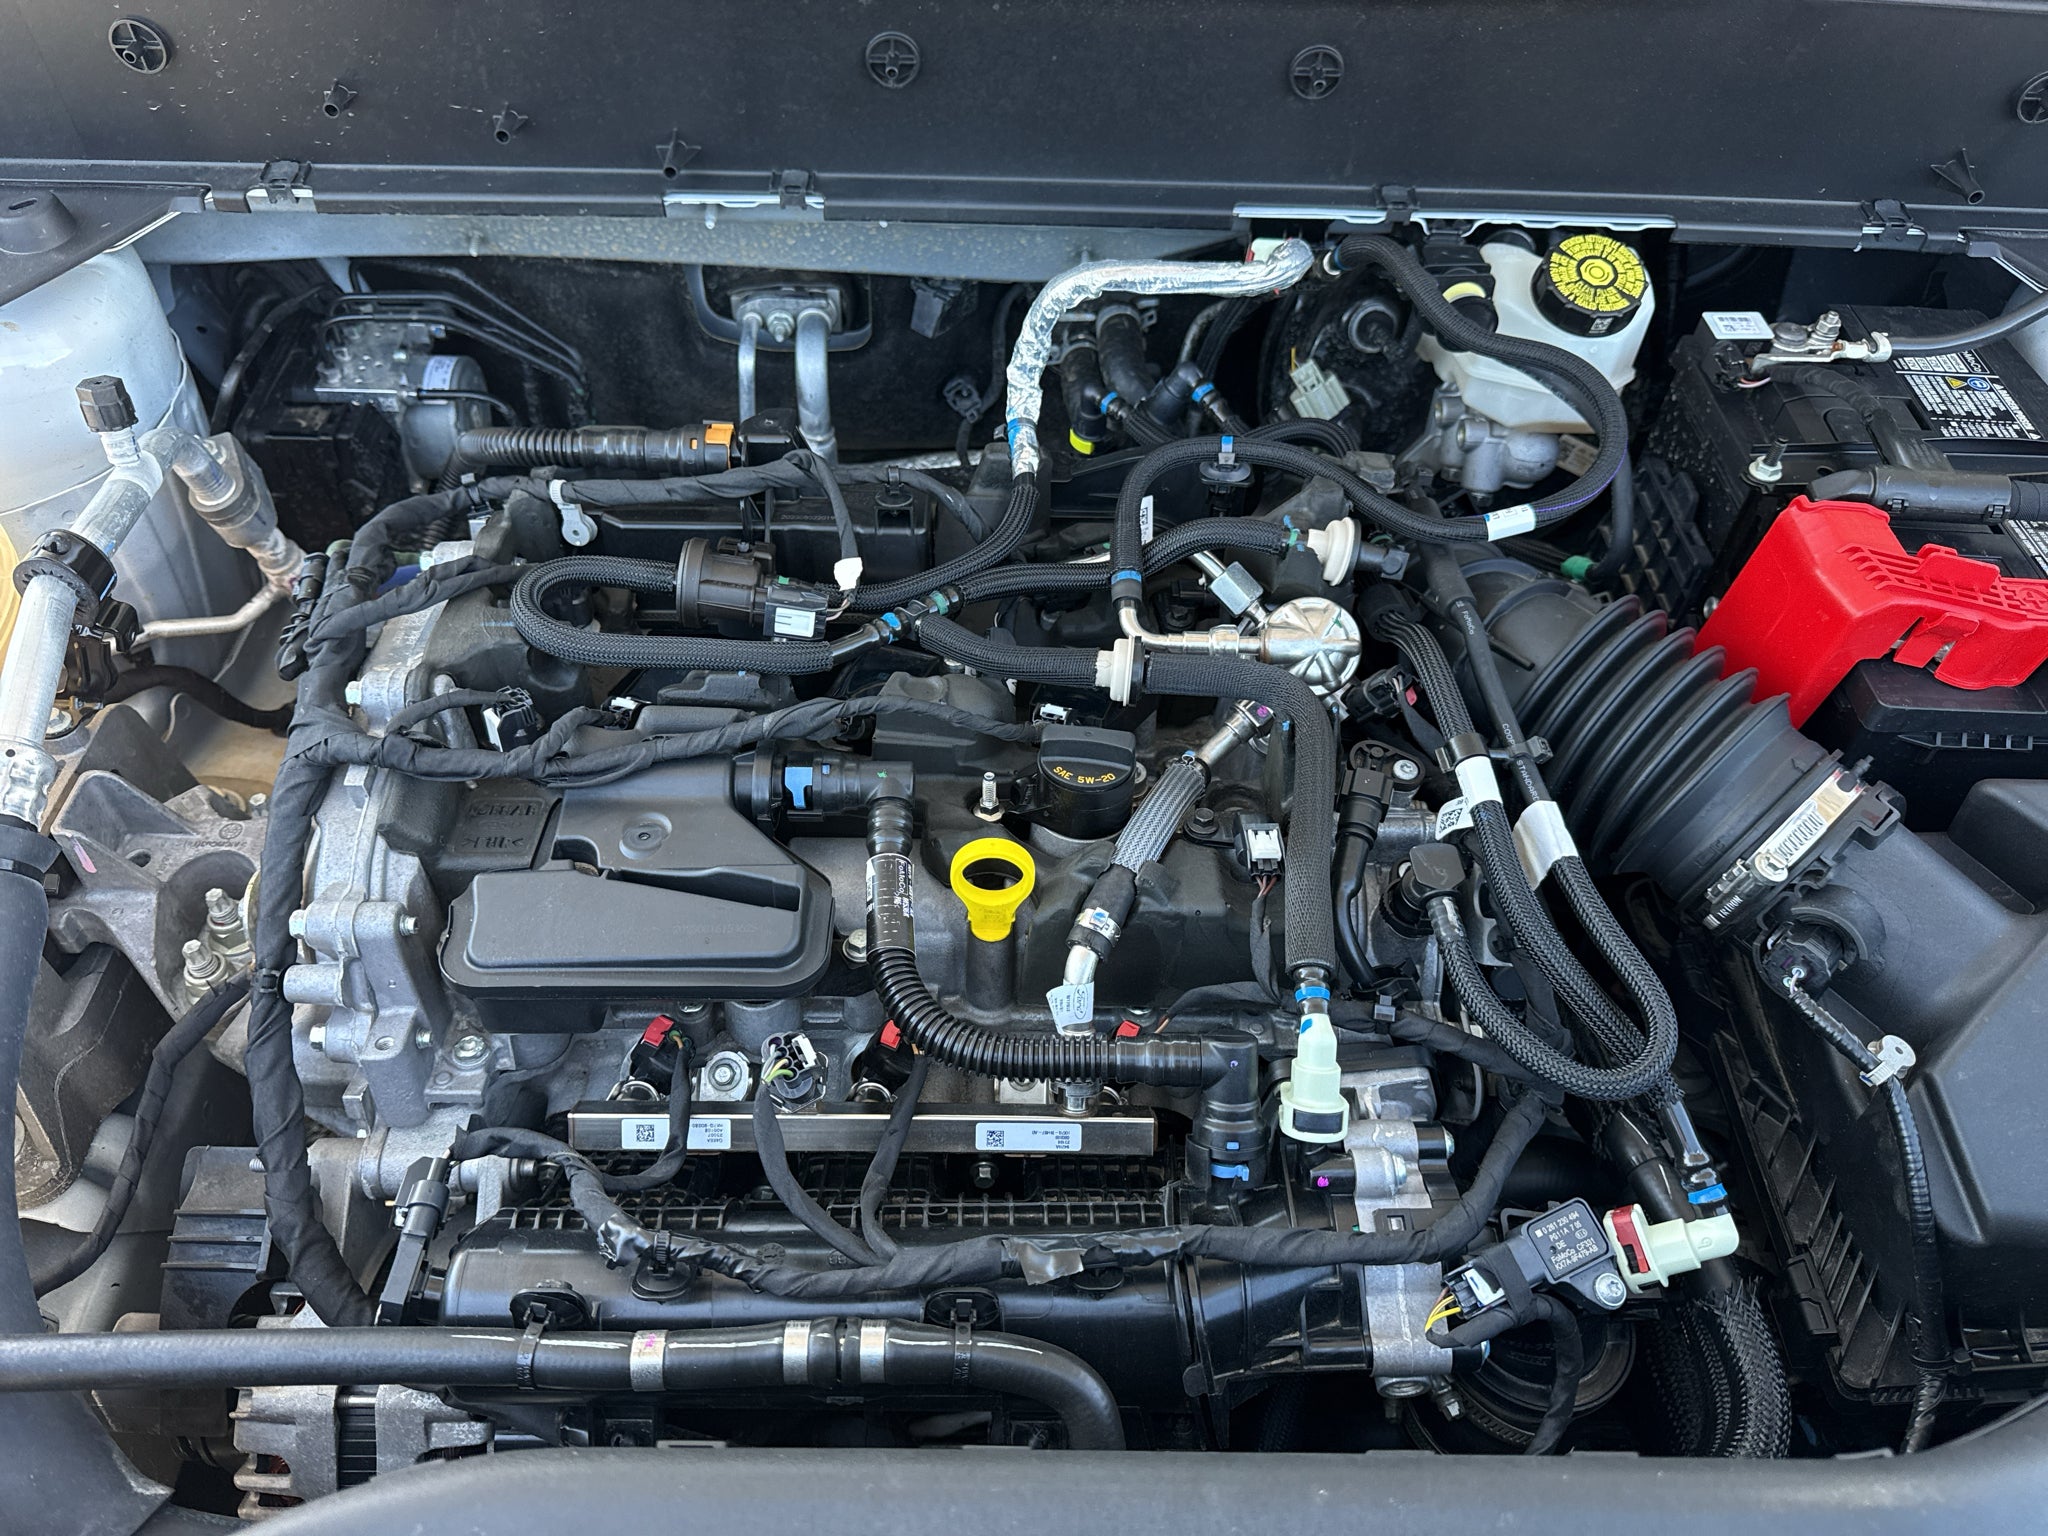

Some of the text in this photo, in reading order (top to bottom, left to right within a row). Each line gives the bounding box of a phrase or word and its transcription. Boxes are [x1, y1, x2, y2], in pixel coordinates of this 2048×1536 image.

[1053, 766, 1116, 784] SAE 5W-20
[1076, 988, 1086, 1014] Ford
[1547, 1222, 1558, 1232] 261
[1557, 1216, 1569, 1226] 230
[1569, 1211, 1579, 1220] 494
[1555, 1240, 1567, 1249] DE
[1551, 1249, 1575, 1264] FoMoCo
